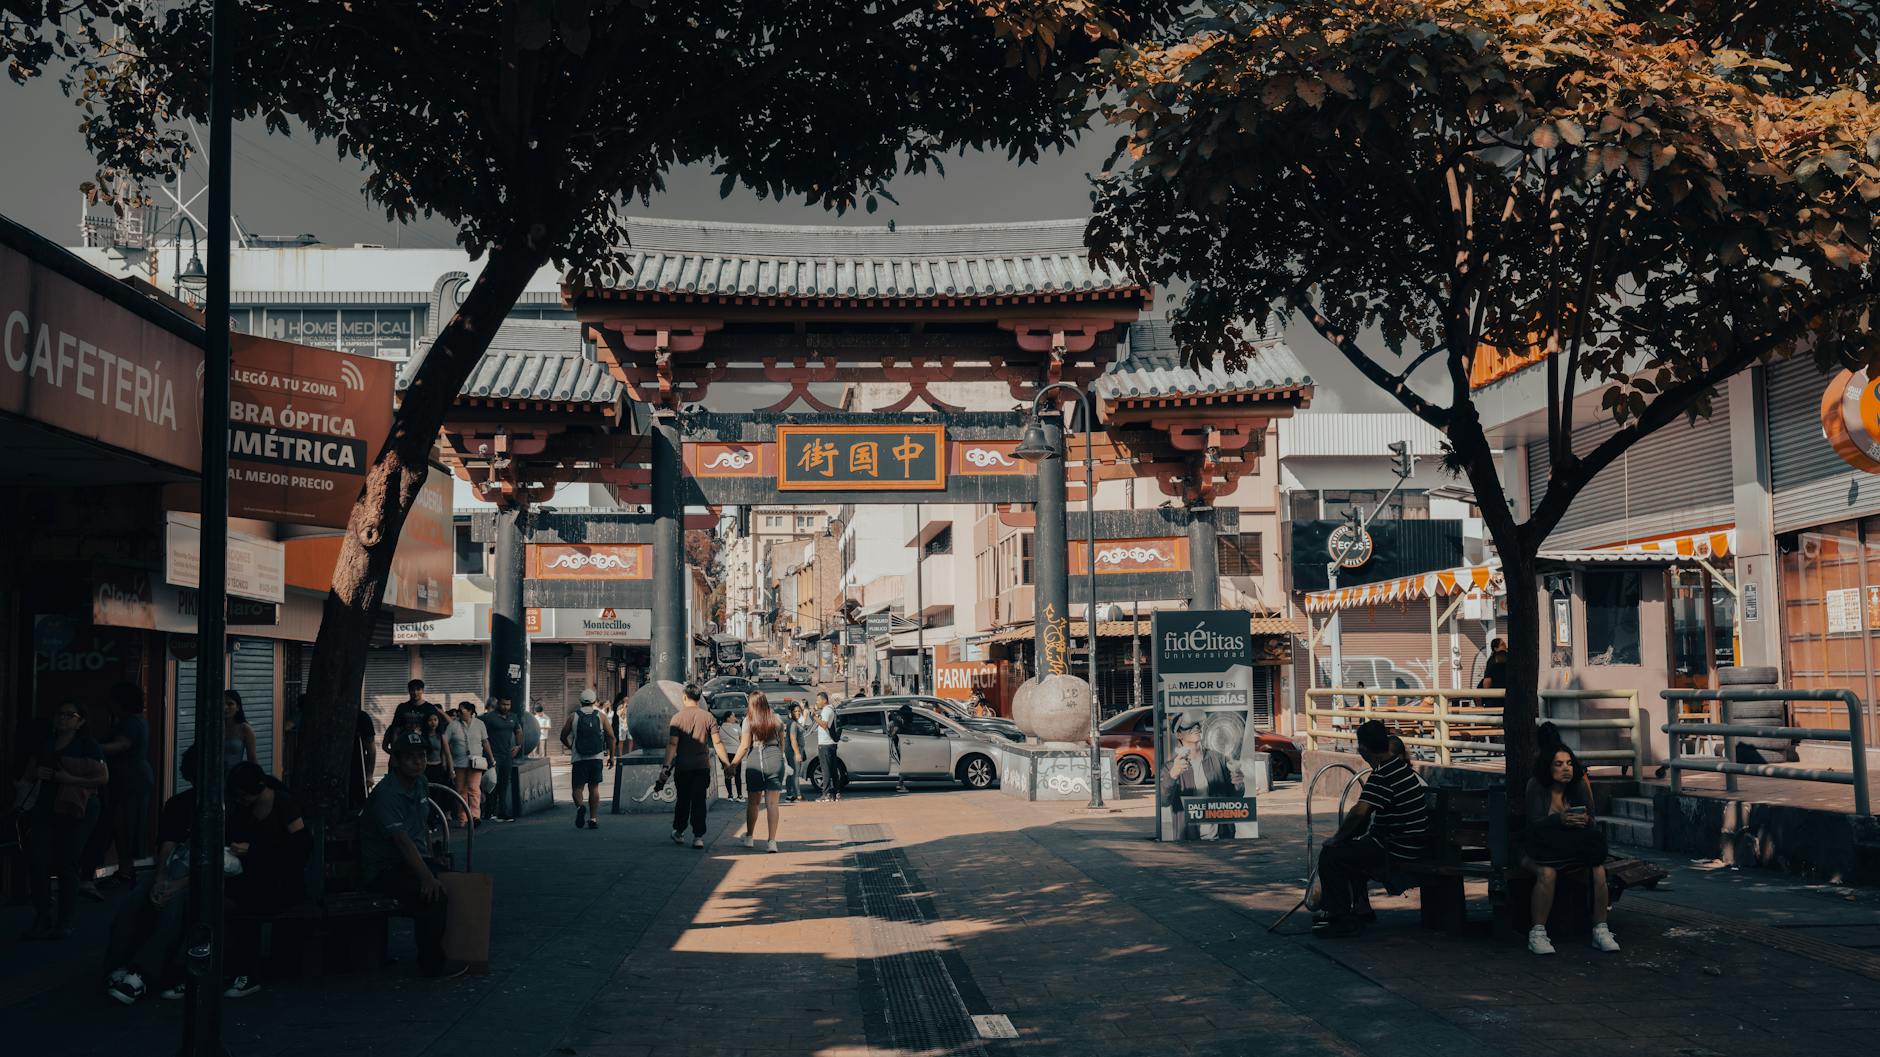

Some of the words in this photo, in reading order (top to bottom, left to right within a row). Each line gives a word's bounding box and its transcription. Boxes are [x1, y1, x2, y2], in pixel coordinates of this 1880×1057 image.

[289, 321, 336, 335] HOME
[342, 321, 410, 335] MEDICAL
[4, 310, 177, 431] CAFETERÍA
[231, 368, 268, 386] LEGÓ
[271, 375, 280, 388] A
[283, 377, 299, 391] TU
[302, 380, 337, 397] ZONA
[230, 400, 276, 426] BRA
[280, 404, 356, 437] ÓPTICA
[228, 428, 356, 468] IMÉTRICA
[227, 468, 243, 480] AL
[246, 470, 288, 486] MEJOR
[291, 475, 334, 491] PRECIO
[228, 597, 264, 616] laro
[395, 622, 435, 631] tecillos
[583, 619, 631, 630] Montecillos
[1164, 621, 1244, 651] fidélitas
[1164, 650, 1245, 659] Universidad
[1179, 681, 1214, 689] MEJOR
[1216, 681, 1223, 689] U
[1170, 692, 1245, 705] INGENIERÍAS
[1208, 802, 1242, 810] MUNDO
[1188, 810, 1204, 819] TU
[1205, 809, 1249, 818] INGENIO
